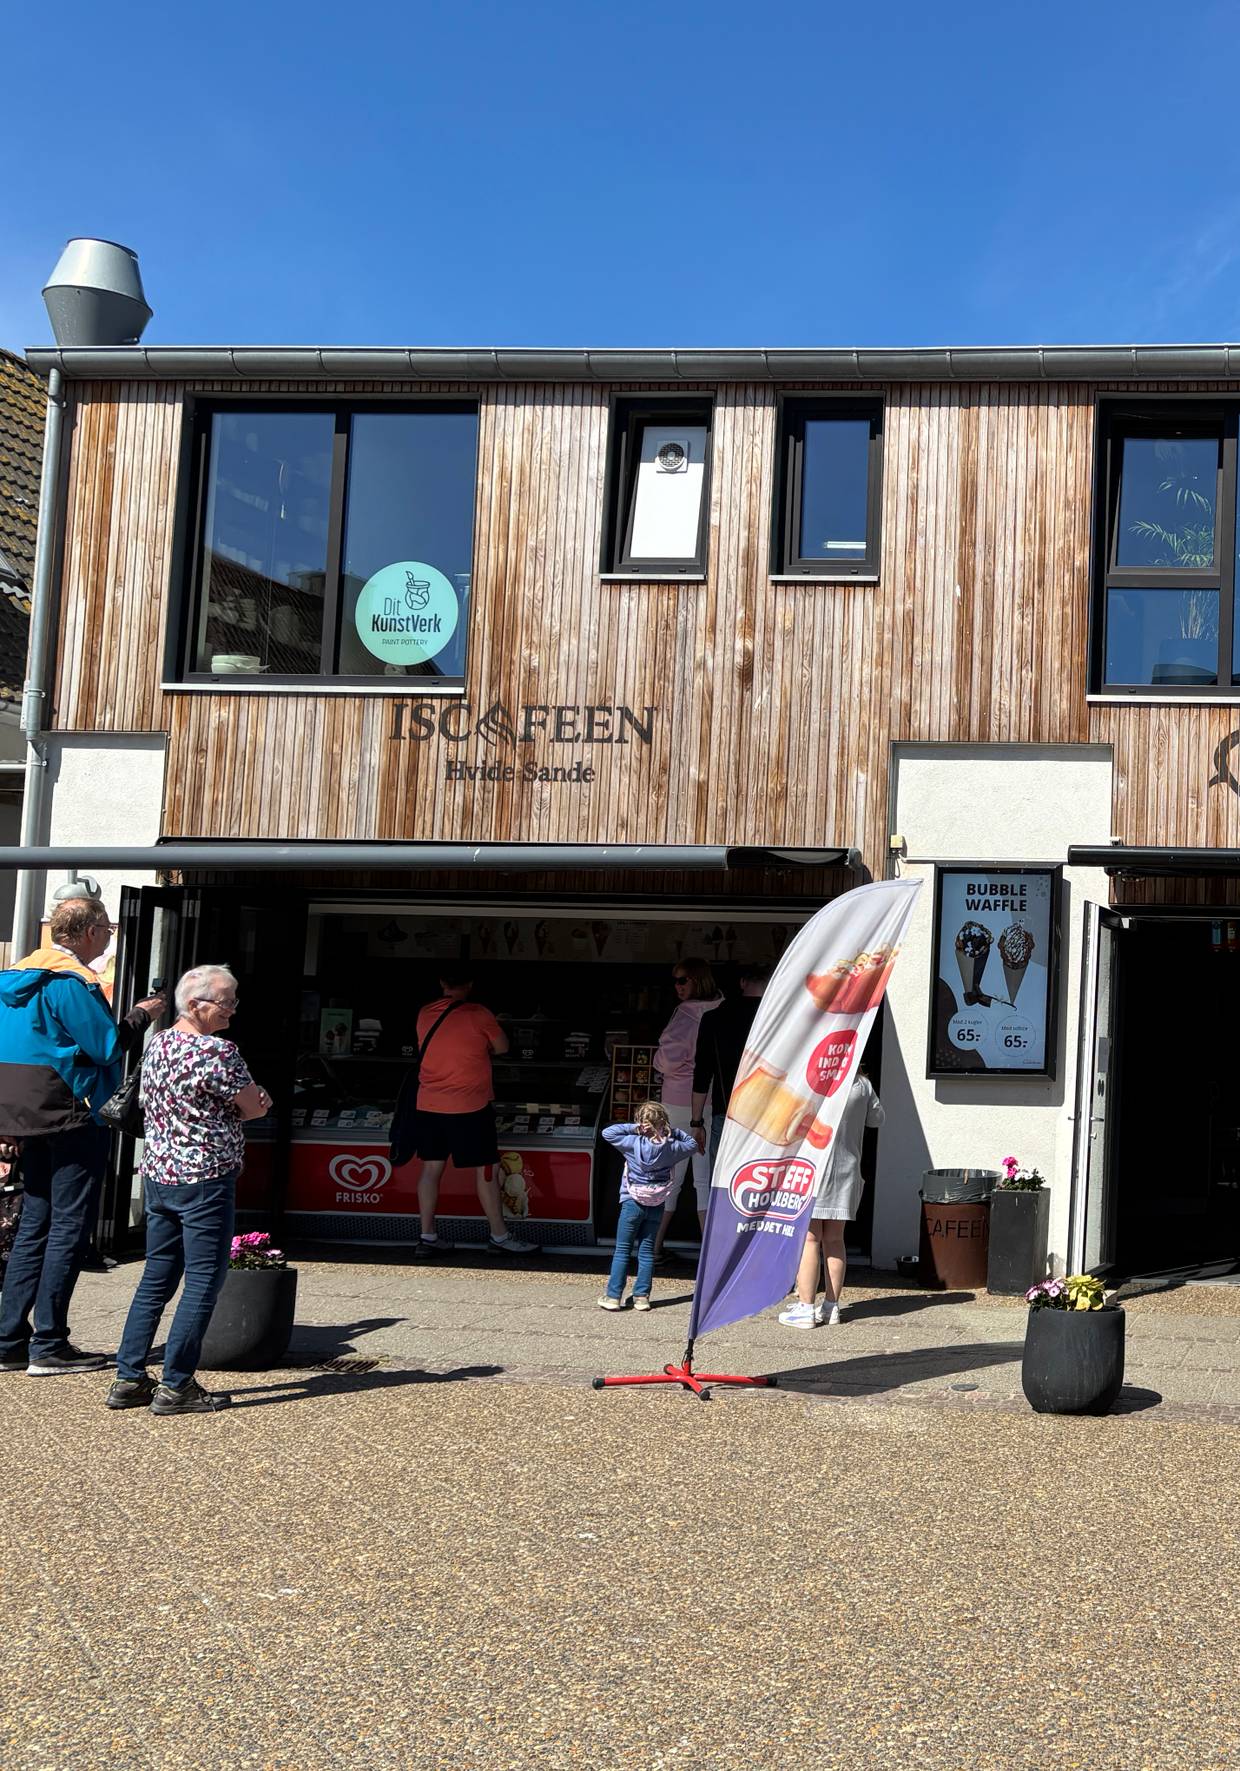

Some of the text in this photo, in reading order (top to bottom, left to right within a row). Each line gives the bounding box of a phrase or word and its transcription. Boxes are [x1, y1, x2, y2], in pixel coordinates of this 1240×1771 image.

[384, 598, 400, 615] Dit
[371, 613, 441, 632] KunstVerk
[445, 760, 595, 783] Hvide Sande
[966, 883, 1027, 897] BUBBLE
[965, 899, 1027, 912] WAFFLE
[752, 1165, 812, 1192] STEFF
[336, 1192, 380, 1203] FRISKO
